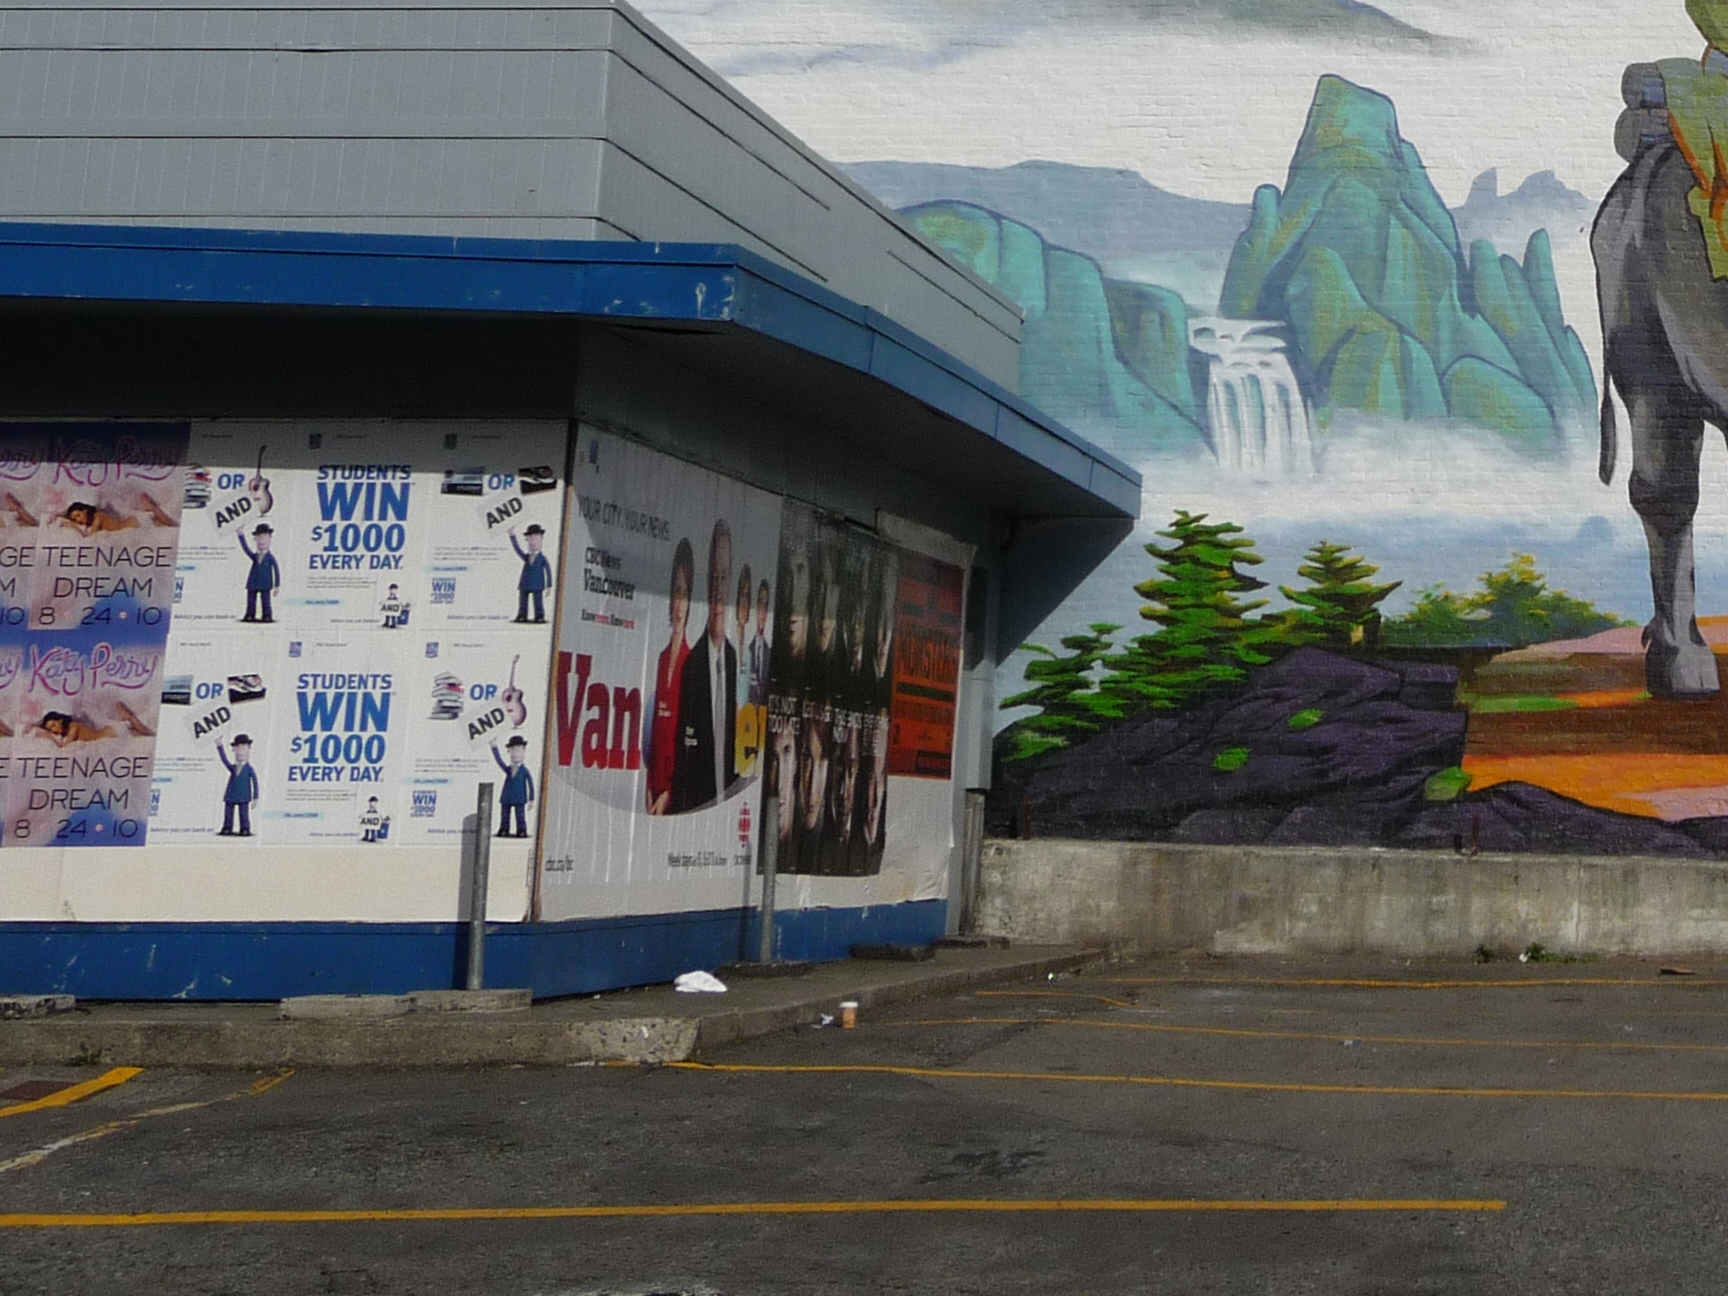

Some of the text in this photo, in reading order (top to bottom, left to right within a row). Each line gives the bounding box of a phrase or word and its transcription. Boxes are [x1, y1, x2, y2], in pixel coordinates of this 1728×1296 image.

[217, 473, 246, 490] OR
[317, 464, 412, 480] STUDENTS
[488, 473, 516, 490] OR
[214, 496, 253, 529] AND
[316, 482, 409, 522] WIN
[485, 496, 523, 530] AND
[311, 523, 406, 553] $1000
[41, 546, 173, 568] TEENAGE
[309, 554, 366, 570] EVERY
[53, 577, 153, 599] DREAM
[38, 606, 163, 626] 8 24 10
[380, 604, 400, 612] AND
[28, 645, 88, 696] Katy
[90, 642, 159, 689] Perry
[195, 682, 224, 700] OR
[297, 673, 393, 690] STUDENTS
[469, 683, 498, 700] OR
[296, 691, 389, 732] WIN
[193, 705, 232, 740] AND
[466, 706, 506, 742] AND
[290, 734, 386, 764] $1000
[16, 756, 149, 779] TEENAGE
[287, 766, 345, 782] EVERY
[29, 789, 129, 810] DREAM
[13, 819, 139, 839] 8 24 10
[360, 817, 380, 826] AND
